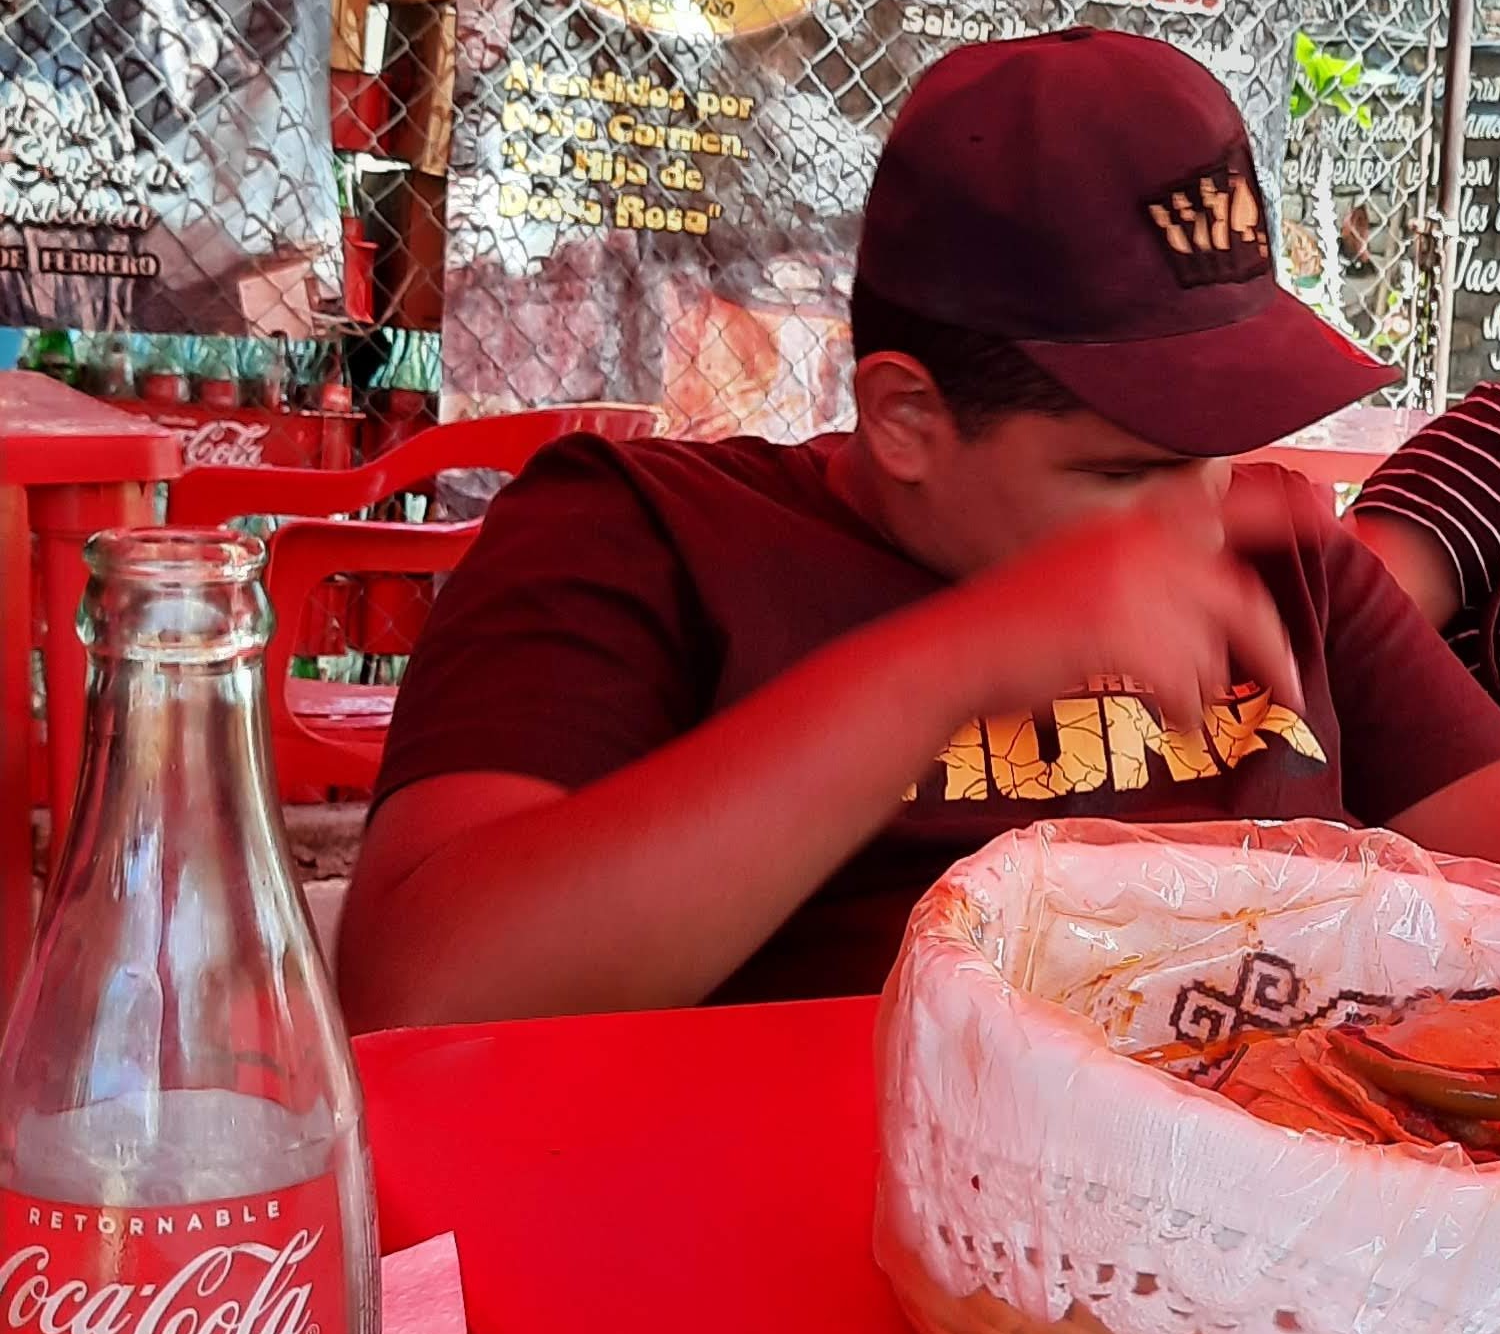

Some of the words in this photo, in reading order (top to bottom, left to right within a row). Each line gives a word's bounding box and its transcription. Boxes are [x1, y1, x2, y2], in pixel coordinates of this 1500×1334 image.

[902, 7, 995, 41] Sabor
[696, 91, 754, 121] por
[573, 147, 648, 190] Hija
[659, 157, 705, 192] de
[28, 1200, 280, 1236] RETORNABLE
